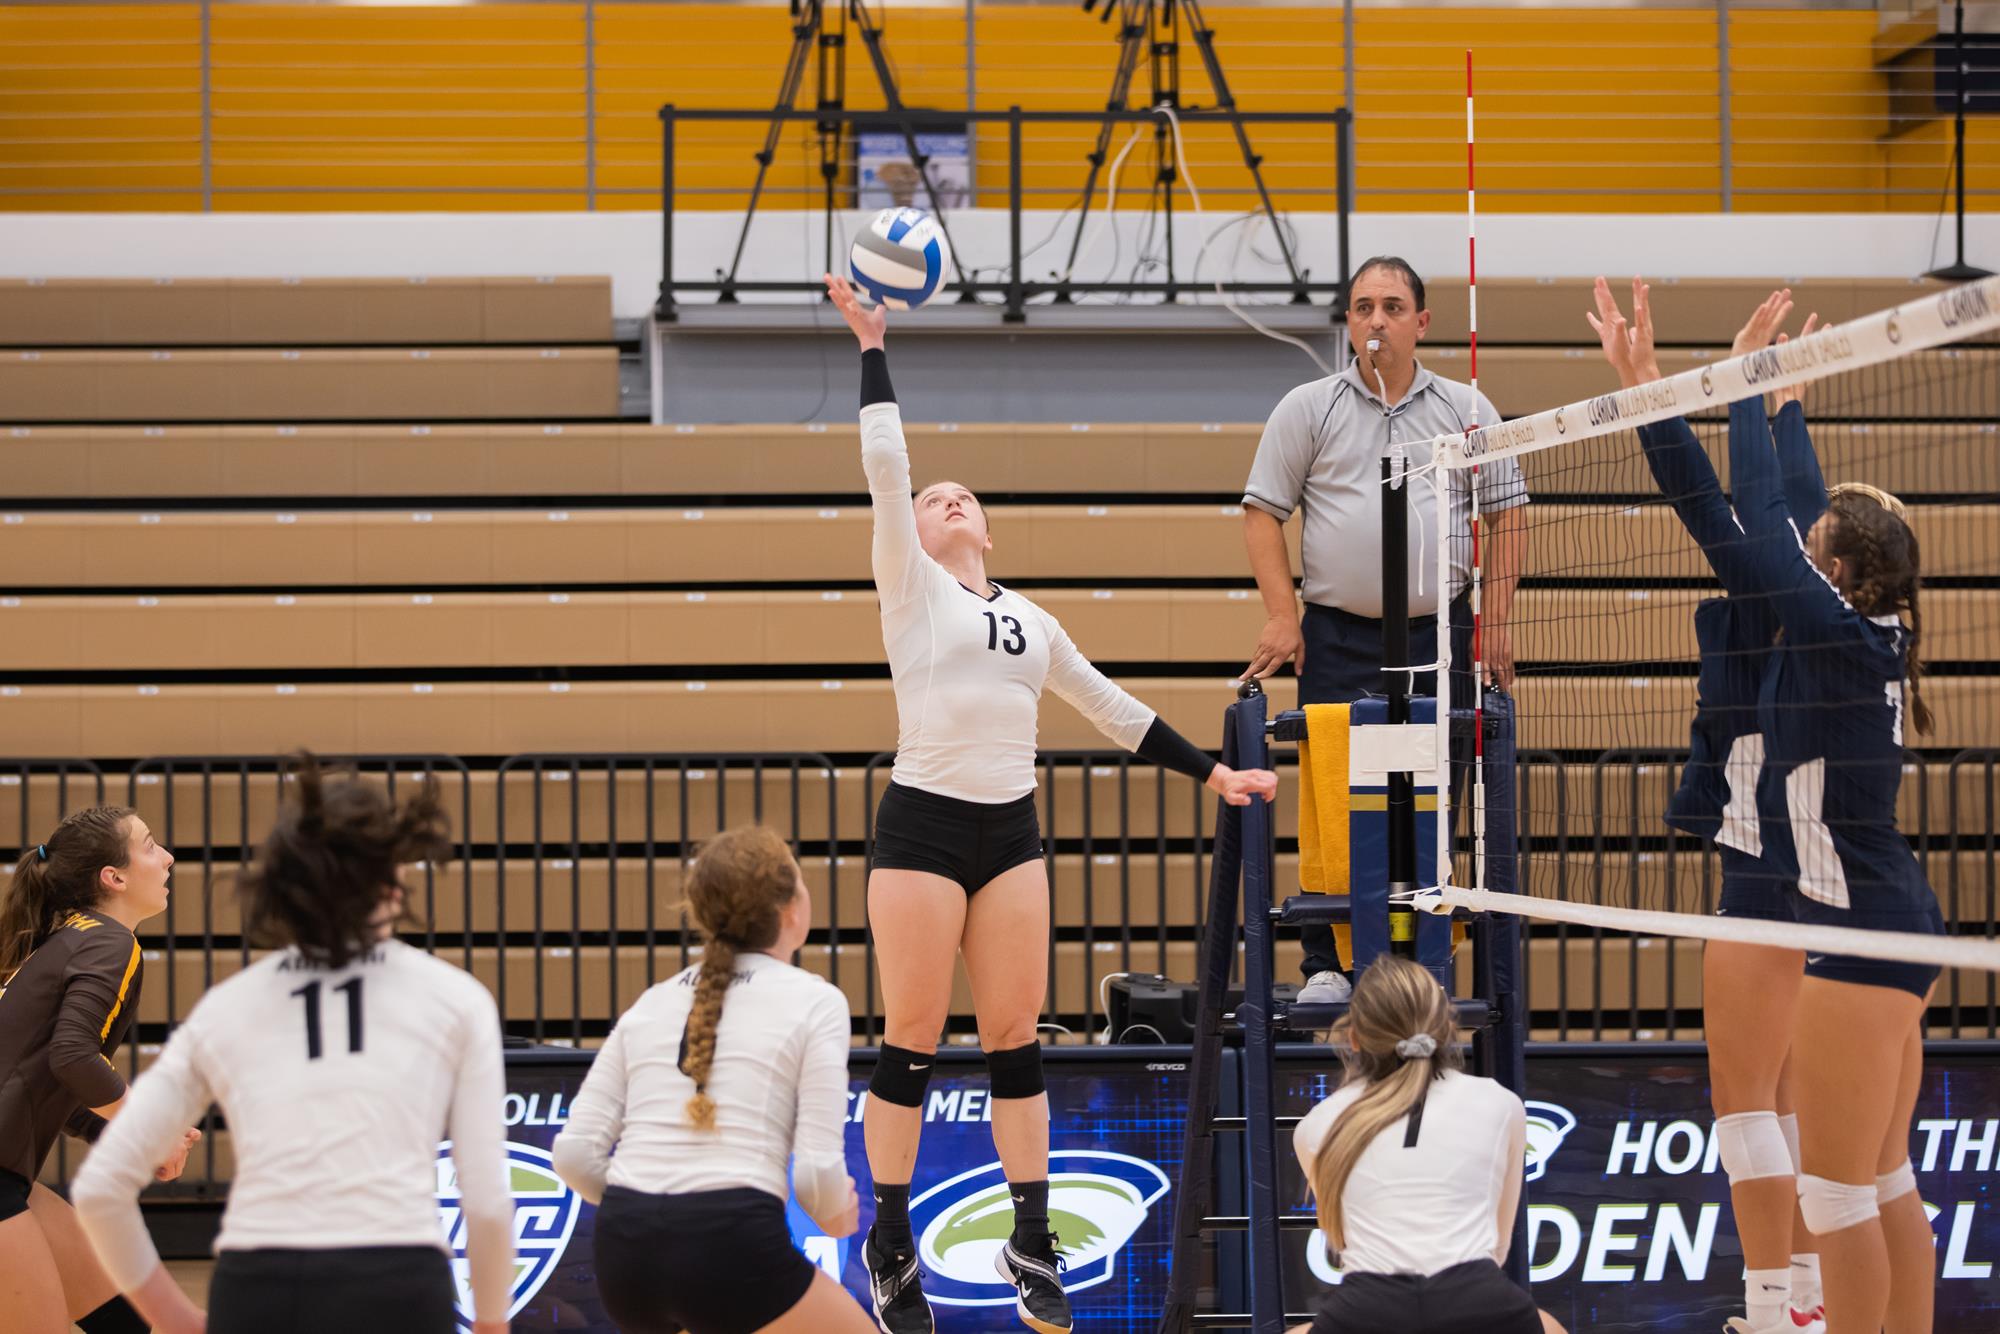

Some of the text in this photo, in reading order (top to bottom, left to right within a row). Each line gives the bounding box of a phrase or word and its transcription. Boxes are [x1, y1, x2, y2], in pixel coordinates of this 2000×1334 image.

[1742, 350, 1783, 385] CLARION
[1588, 395, 1620, 426] CLARION
[1463, 429, 1488, 458] CLARION
[983, 611, 1026, 656] 13
[290, 976, 364, 1060] 11
